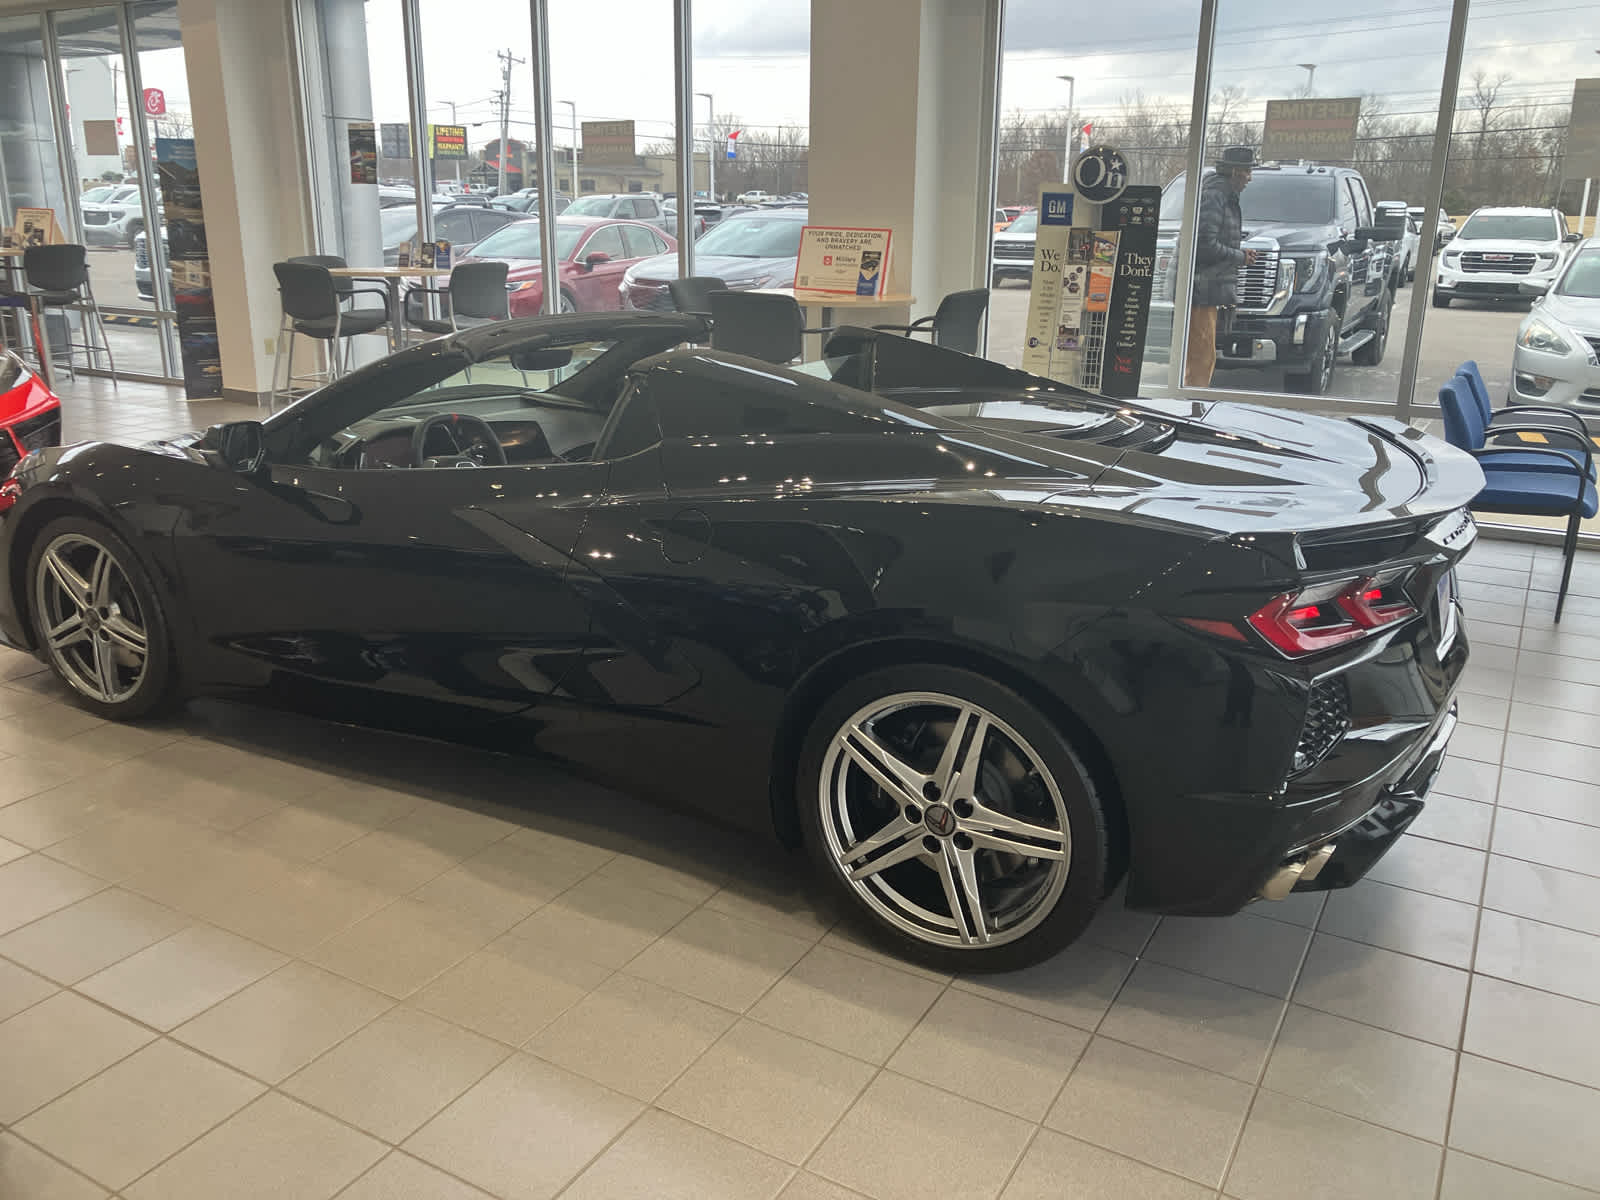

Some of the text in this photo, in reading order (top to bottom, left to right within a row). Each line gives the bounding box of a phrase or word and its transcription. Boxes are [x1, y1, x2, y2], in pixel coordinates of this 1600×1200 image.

[1076, 155, 1123, 189] On
[1048, 200, 1066, 216] GM
[1040, 248, 1061, 261] We
[1125, 252, 1153, 267] They
[1041, 261, 1061, 273] Do.
